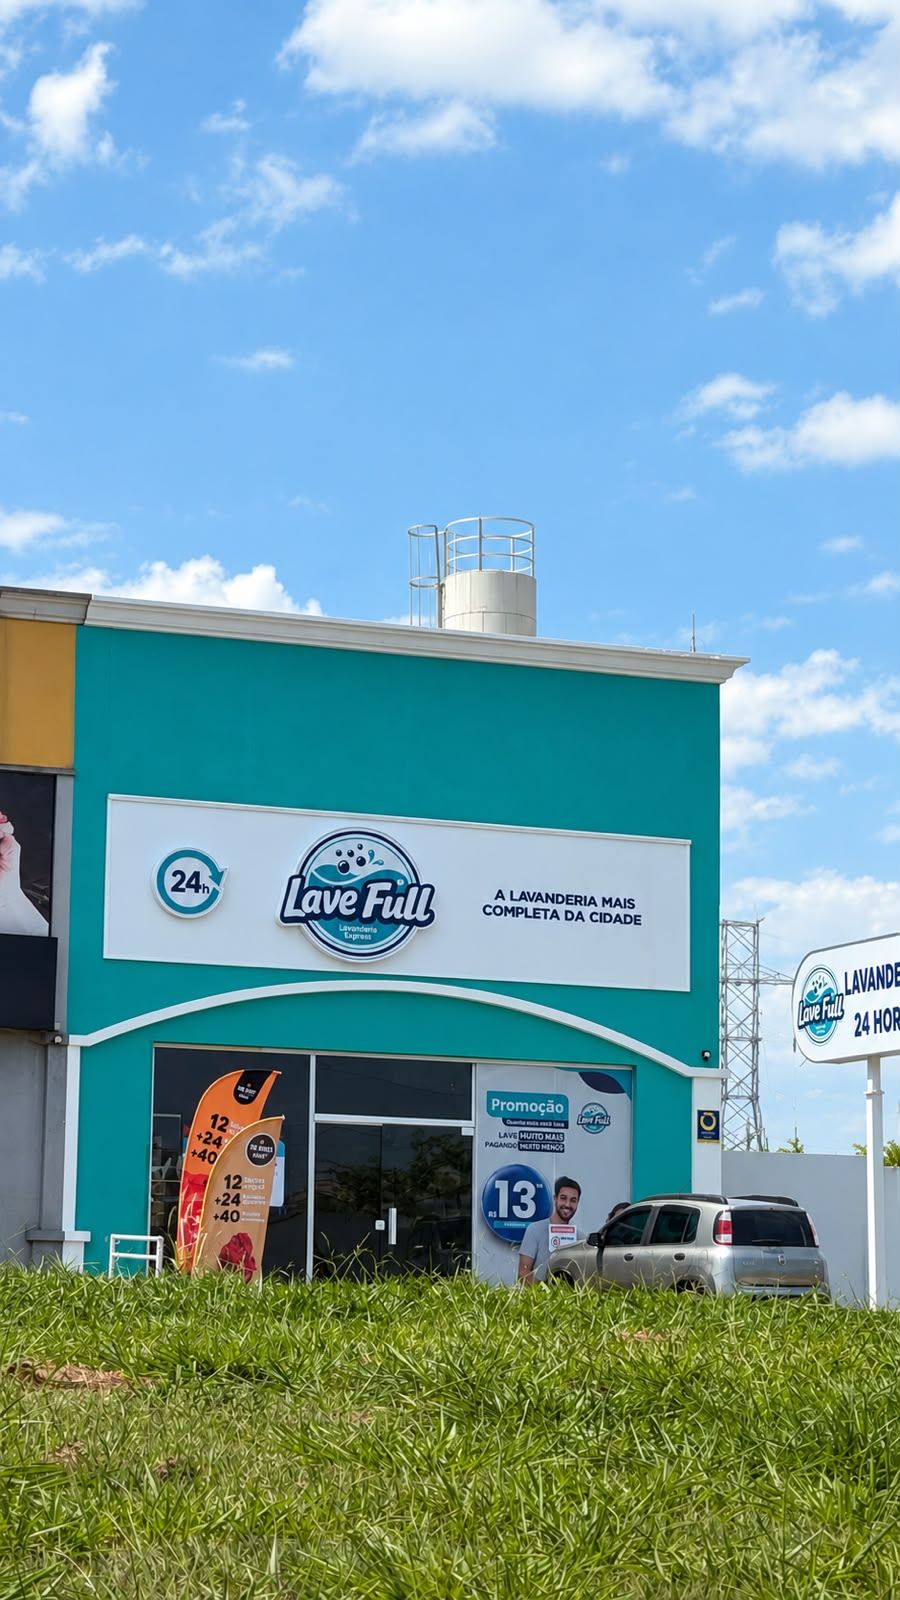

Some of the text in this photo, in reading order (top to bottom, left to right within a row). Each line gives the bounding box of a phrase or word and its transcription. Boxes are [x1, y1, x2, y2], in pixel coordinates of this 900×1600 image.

[171, 870, 210, 894] 24h
[282, 876, 432, 923] Lave Full
[494, 889, 636, 910] A LAVANDERIA MAIS
[482, 904, 642, 926] COMPLETA DA CIDADE
[844, 962, 900, 996] LAVANDE
[798, 994, 844, 1026] Lave Full
[854, 1006, 900, 1037] 24 HOR
[491, 1098, 564, 1117] Promoção
[210, 1113, 230, 1133] 12
[196, 1131, 223, 1149] +24
[484, 1141, 518, 1149] PAGANDO
[498, 1131, 518, 1139] LAVE
[191, 1148, 218, 1165] +40
[224, 1174, 242, 1190] 12
[214, 1192, 241, 1207] +24
[494, 1180, 537, 1219] 13
[213, 1209, 240, 1223] +40
